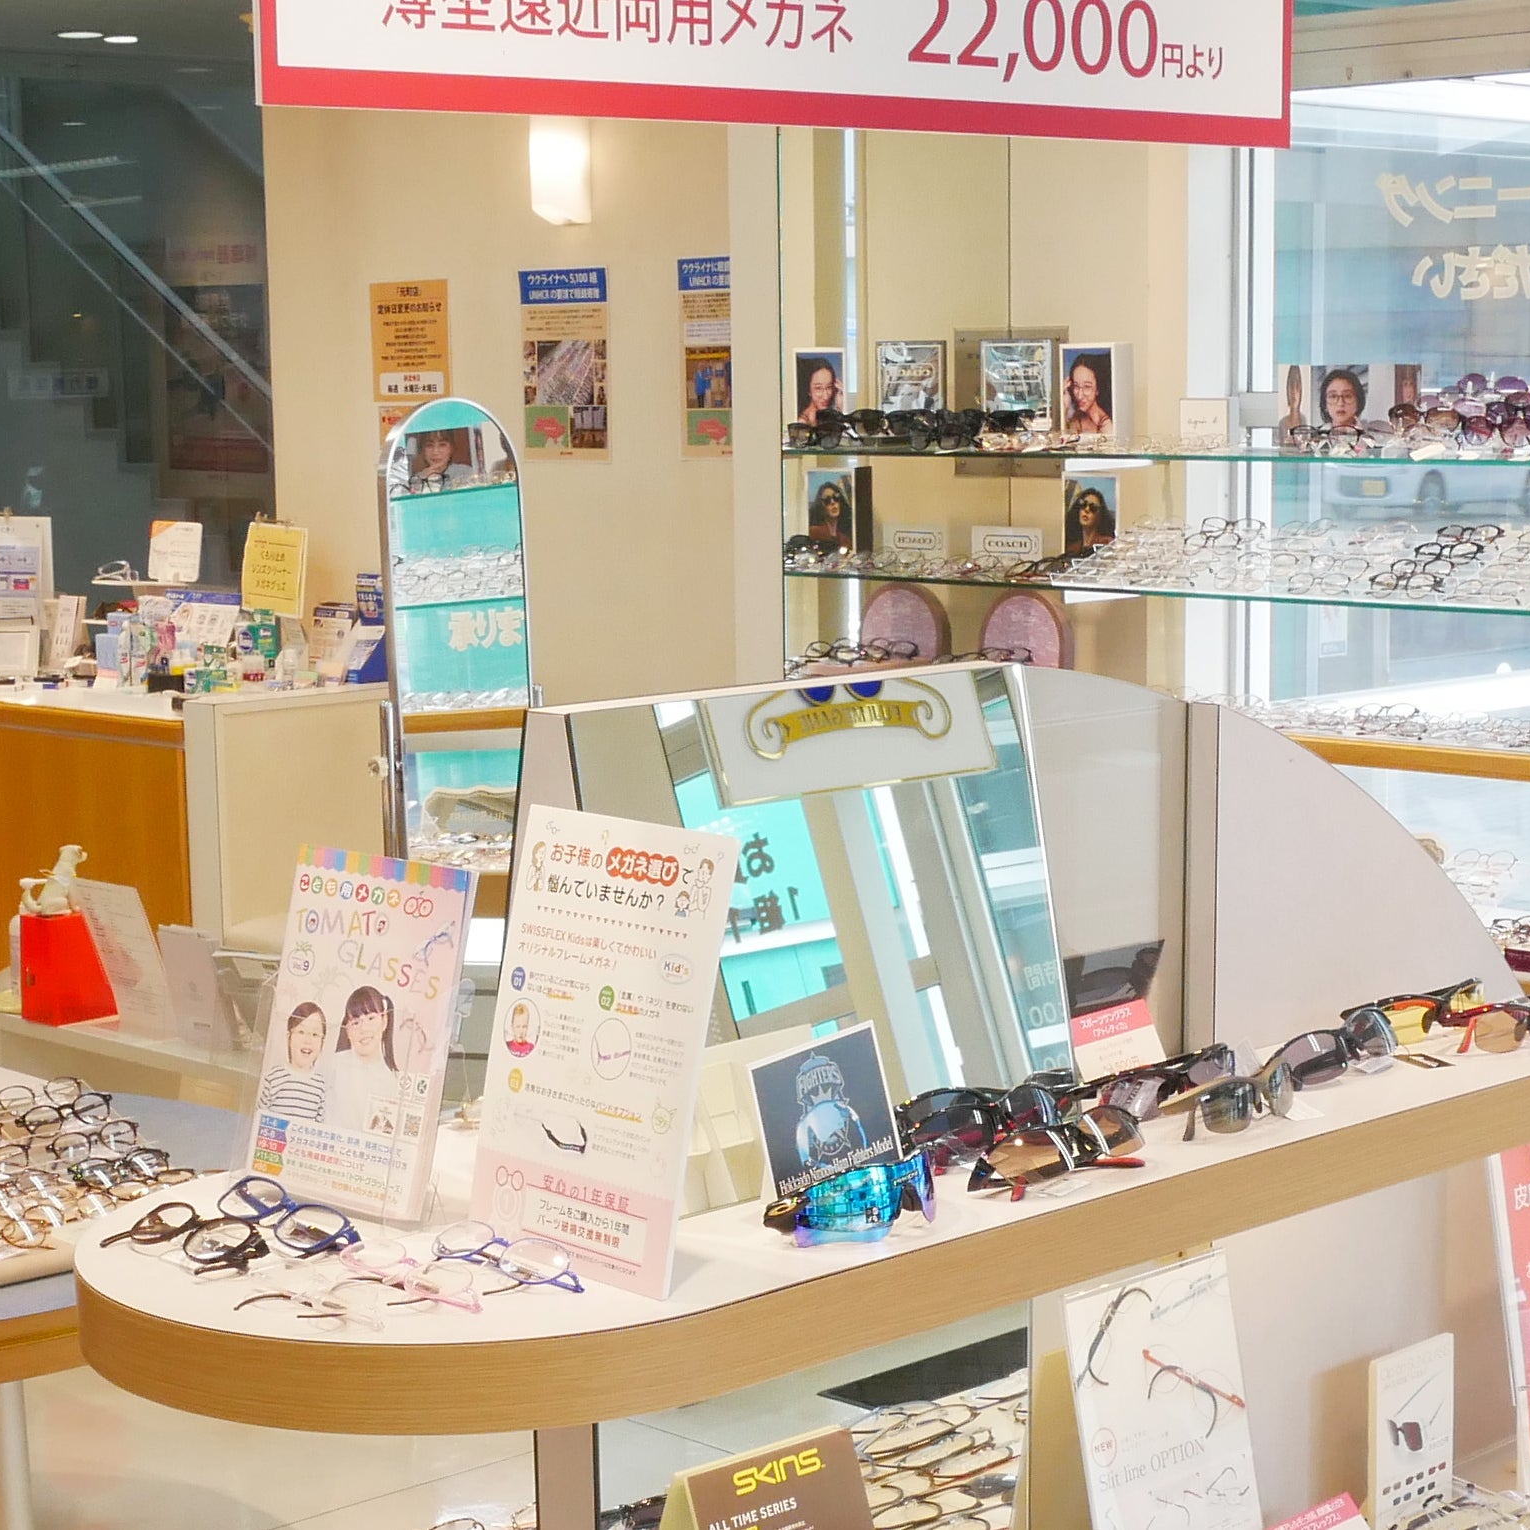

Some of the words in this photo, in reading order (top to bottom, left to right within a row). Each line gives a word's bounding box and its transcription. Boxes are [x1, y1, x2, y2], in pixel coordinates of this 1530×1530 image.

[987, 538, 1030, 549] COACH
[300, 874, 401, 907] こども用メガネ
[296, 908, 390, 938] TOMATO
[337, 938, 441, 1000] GLASSES
[798, 1064, 842, 1093] FIGHTERS
[778, 1169, 810, 1196] Hokkaido
[873, 1136, 893, 1157] Model
[1094, 1440, 1113, 1453] NEW
[1099, 1470, 1121, 1493] Slit
[1124, 1460, 1147, 1484] line
[1150, 1437, 1206, 1473] OPTION
[731, 1510, 759, 1526] TIME
[760, 1497, 798, 1520] SERIES
